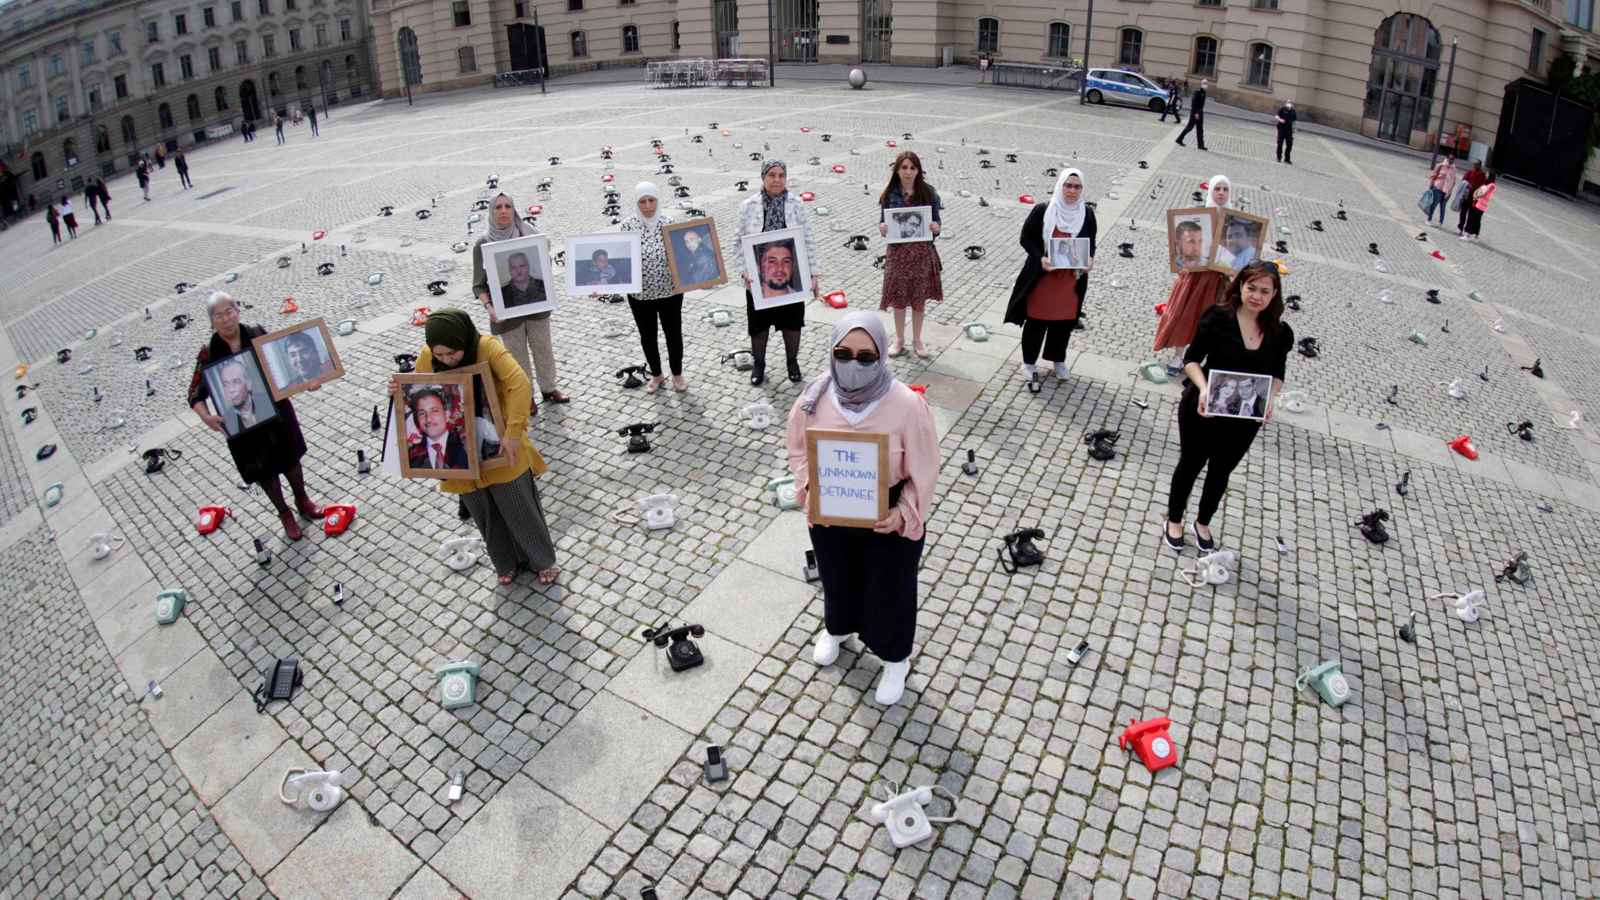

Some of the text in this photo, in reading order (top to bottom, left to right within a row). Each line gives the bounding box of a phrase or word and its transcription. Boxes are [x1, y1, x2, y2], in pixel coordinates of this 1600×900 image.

[833, 449, 862, 463] THE
[818, 466, 876, 480] UNKNOWN
[818, 485, 875, 501] DETAINEE
